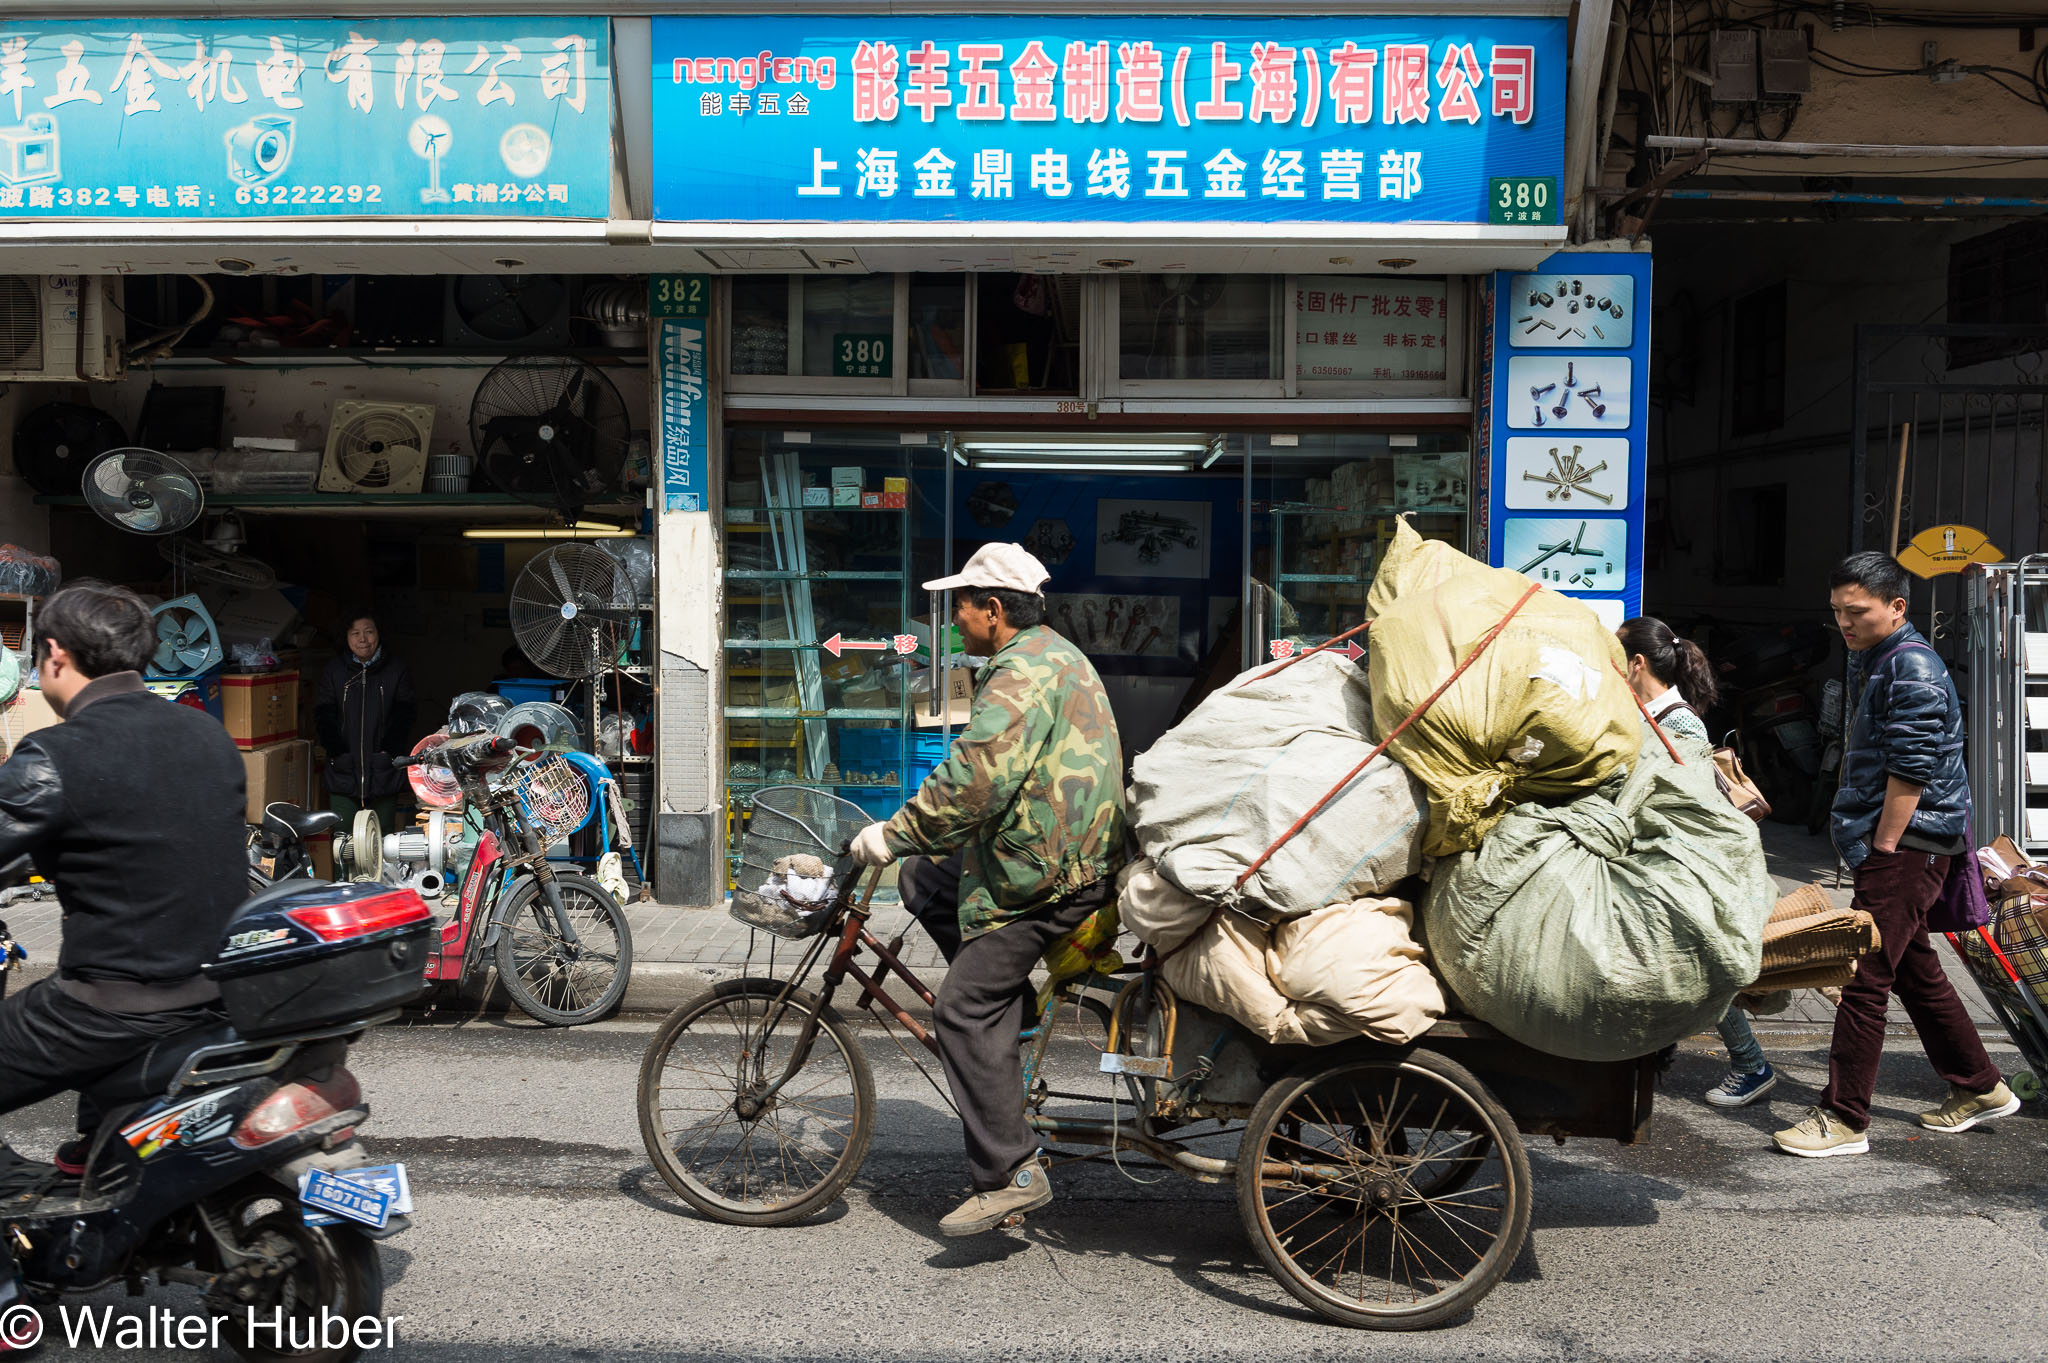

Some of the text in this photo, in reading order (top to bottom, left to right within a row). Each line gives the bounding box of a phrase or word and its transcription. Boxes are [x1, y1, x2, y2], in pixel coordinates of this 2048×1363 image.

[700, 92, 809, 117] 能丰五金
[797, 147, 1424, 200] 上海金鼎电线五金经营部
[451, 182, 569, 203] 黄浦分公司
[1498, 182, 1548, 209] 380
[1503, 210, 1542, 221] 宁波路
[48, 274, 91, 289] Mida
[657, 278, 702, 302] 382
[663, 304, 697, 314] 宁波路
[1296, 332, 1358, 346] 口镙丝
[841, 339, 885, 363] 380
[664, 323, 702, 426] Nedfon
[845, 364, 880, 375] 宁波路
[1056, 401, 1086, 414] 380号
[665, 425, 691, 487] 绿岛风
[893, 634, 918, 655] 移
[1269, 639, 1295, 660] 移
